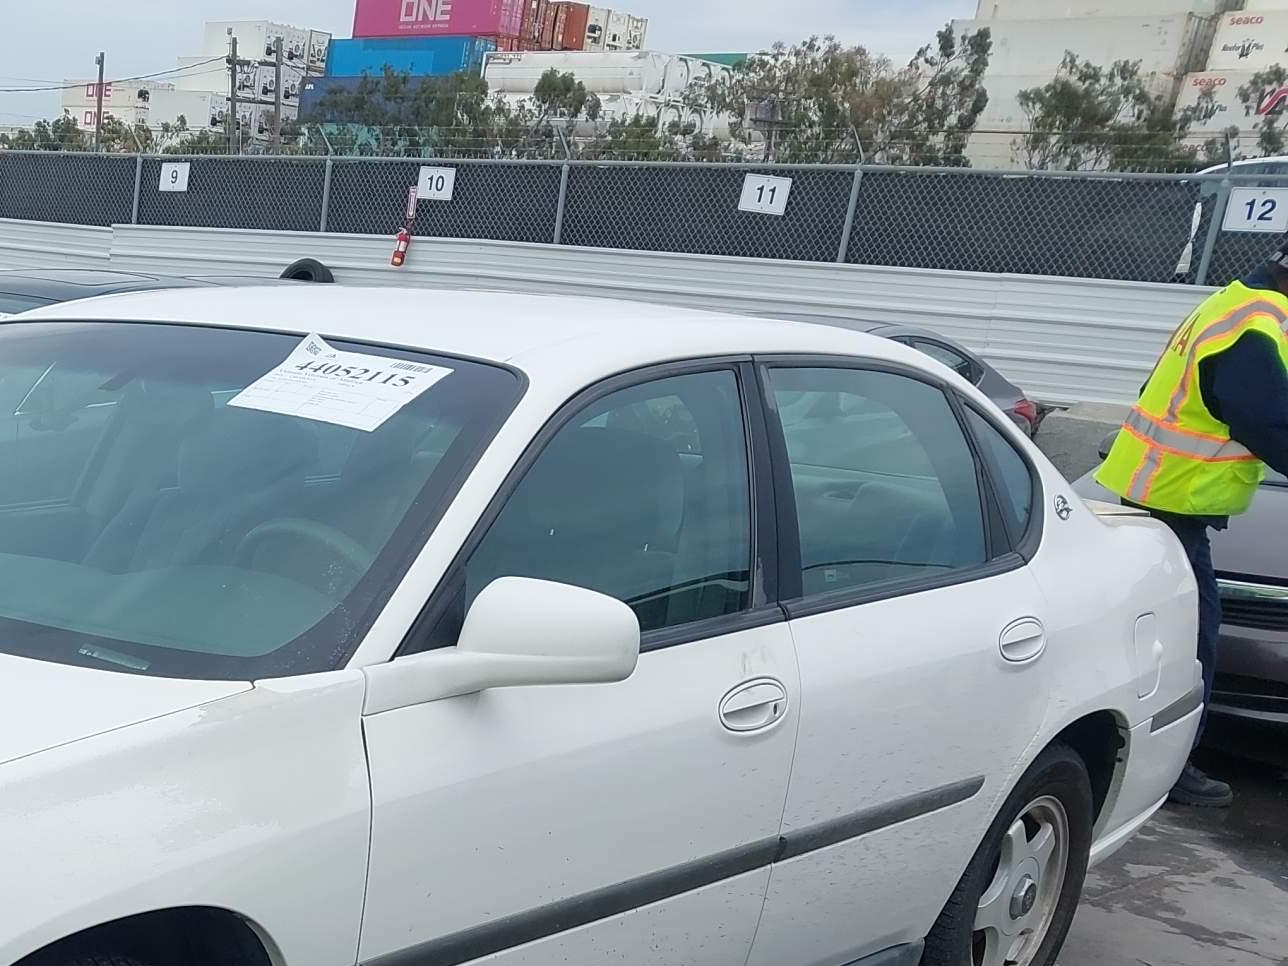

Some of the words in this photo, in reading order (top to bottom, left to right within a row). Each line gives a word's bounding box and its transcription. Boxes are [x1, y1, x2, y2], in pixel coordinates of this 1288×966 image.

[399, 0, 452, 21] ONE
[1229, 15, 1264, 26] seaco
[170, 169, 179, 184] 9
[428, 175, 445, 191] 10
[756, 185, 777, 205] 11
[1245, 198, 1277, 221] 12
[295, 360, 416, 388] 44052115
